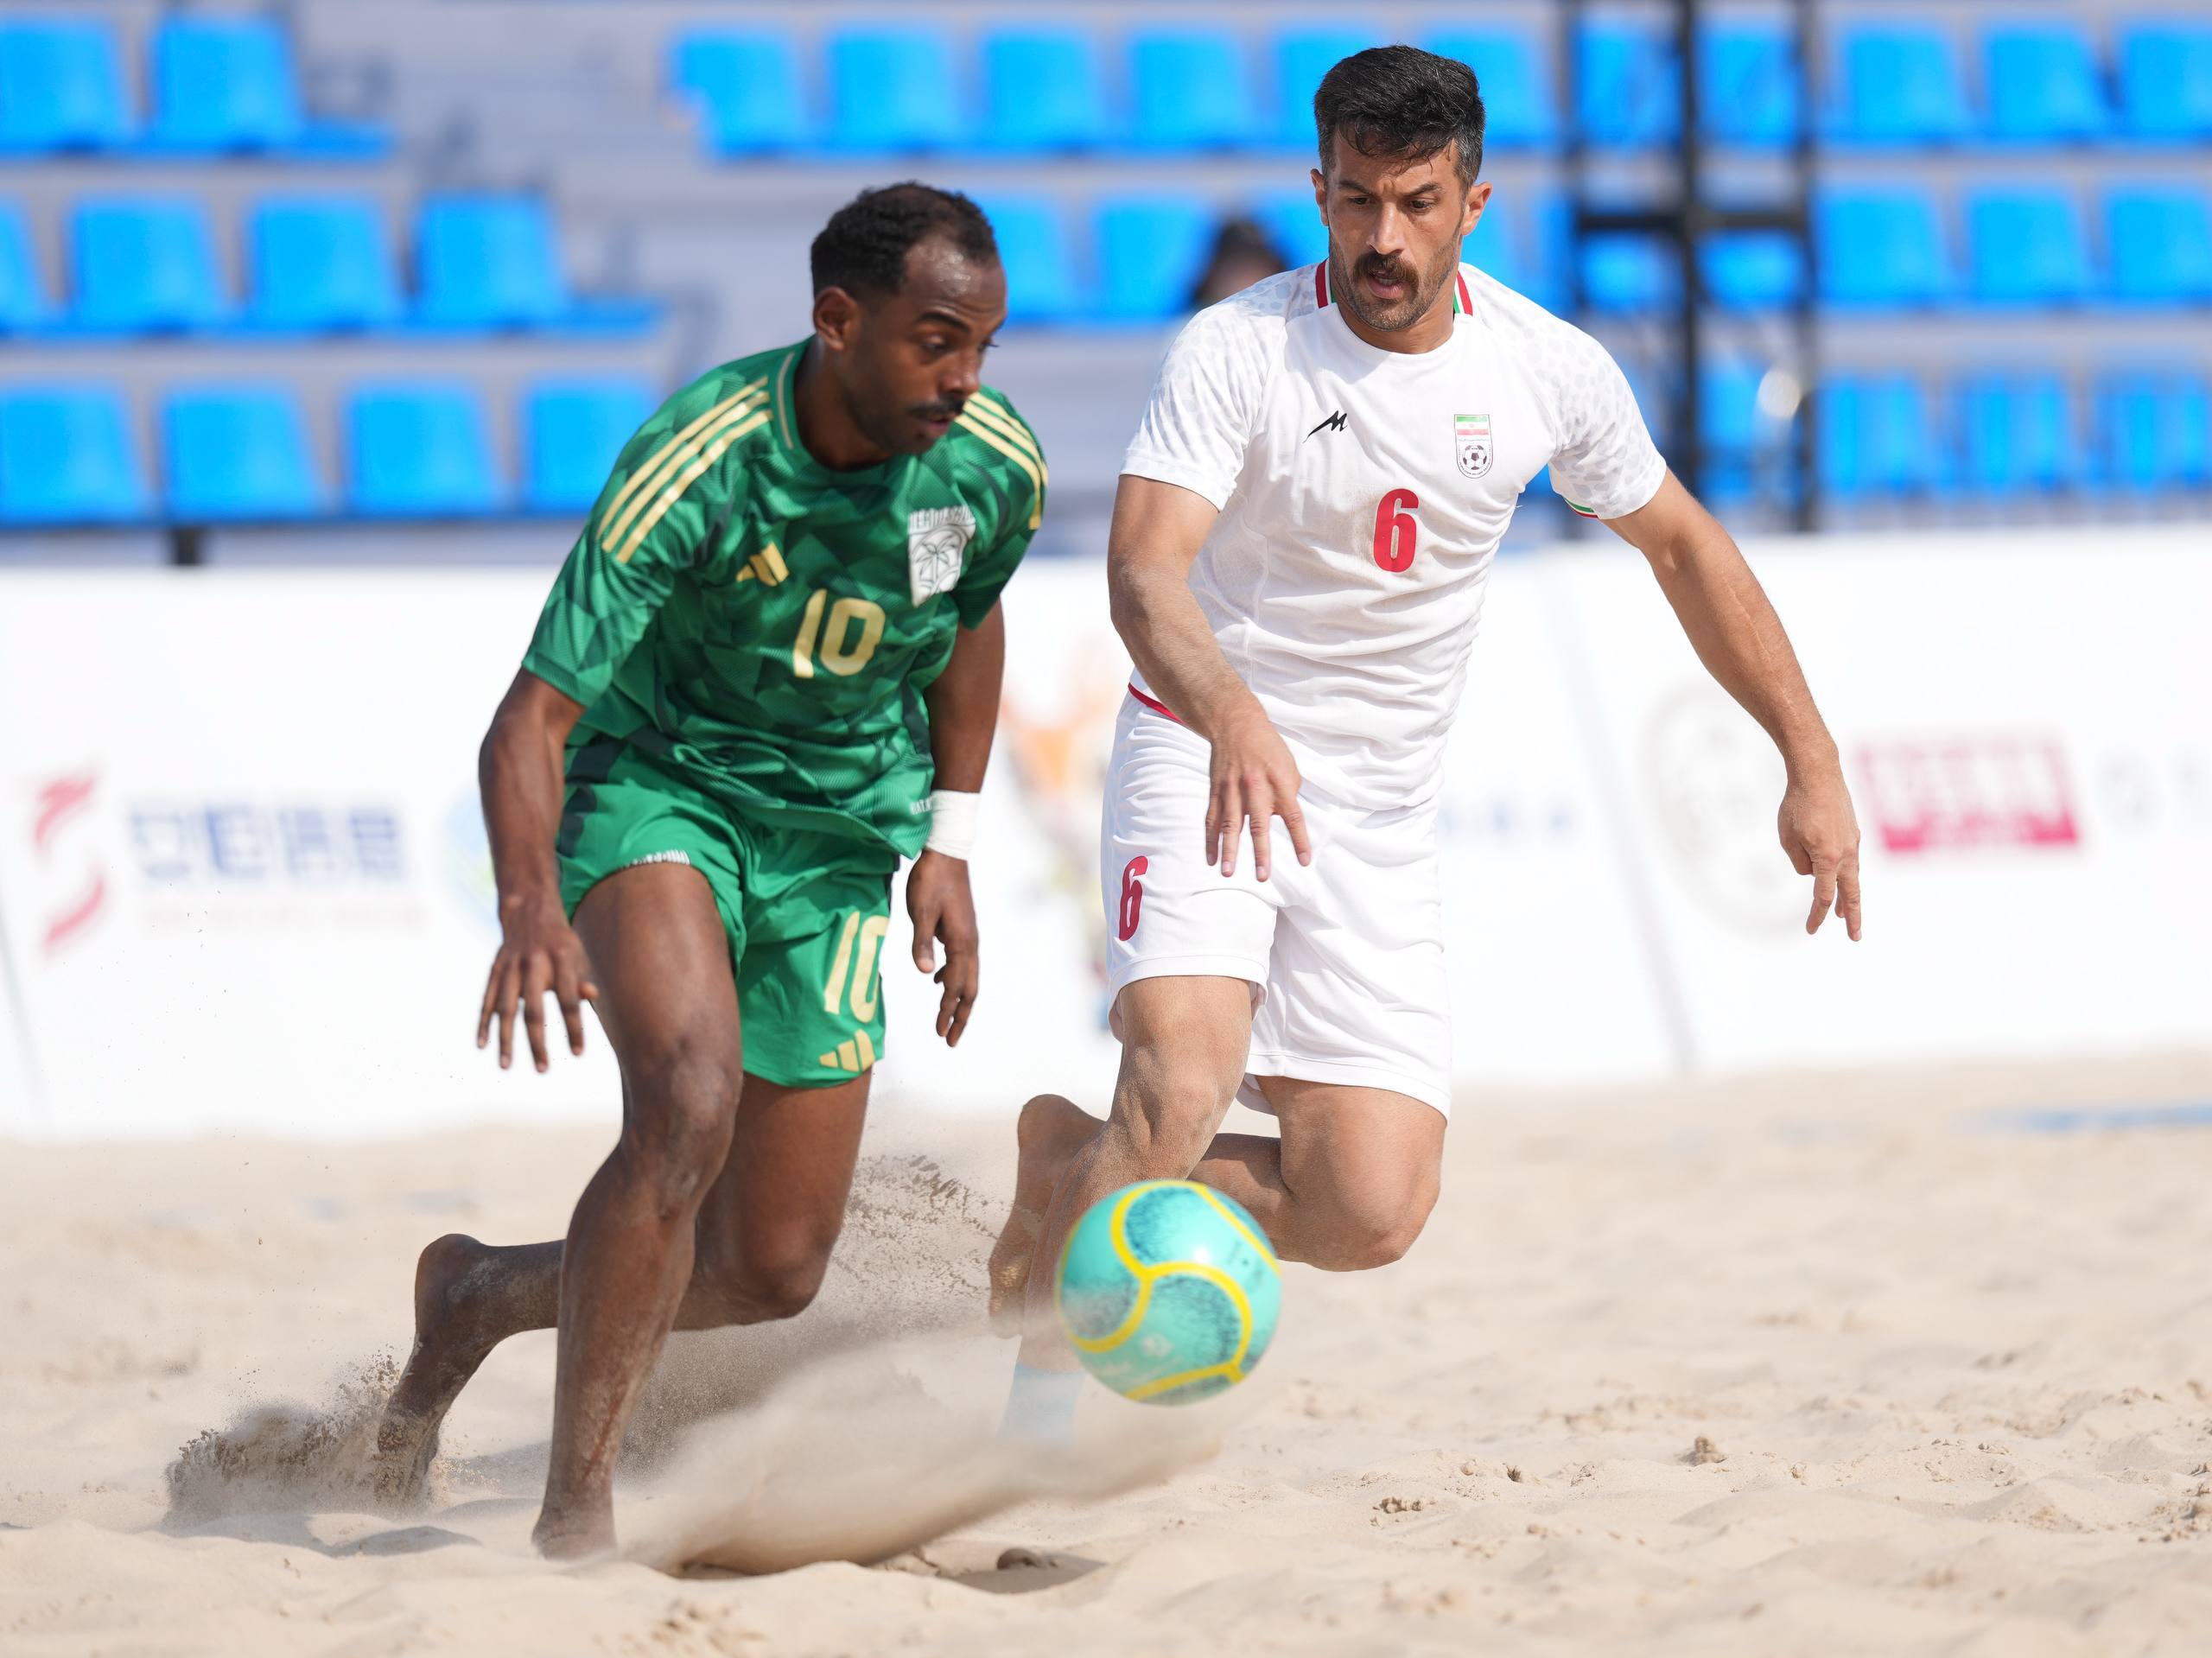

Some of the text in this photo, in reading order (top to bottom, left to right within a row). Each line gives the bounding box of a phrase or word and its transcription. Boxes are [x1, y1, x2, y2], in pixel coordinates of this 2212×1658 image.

[1373, 488, 1419, 573] 6
[793, 588, 886, 678] 10
[1118, 855, 1148, 941] 6
[824, 912, 890, 1023] 10
